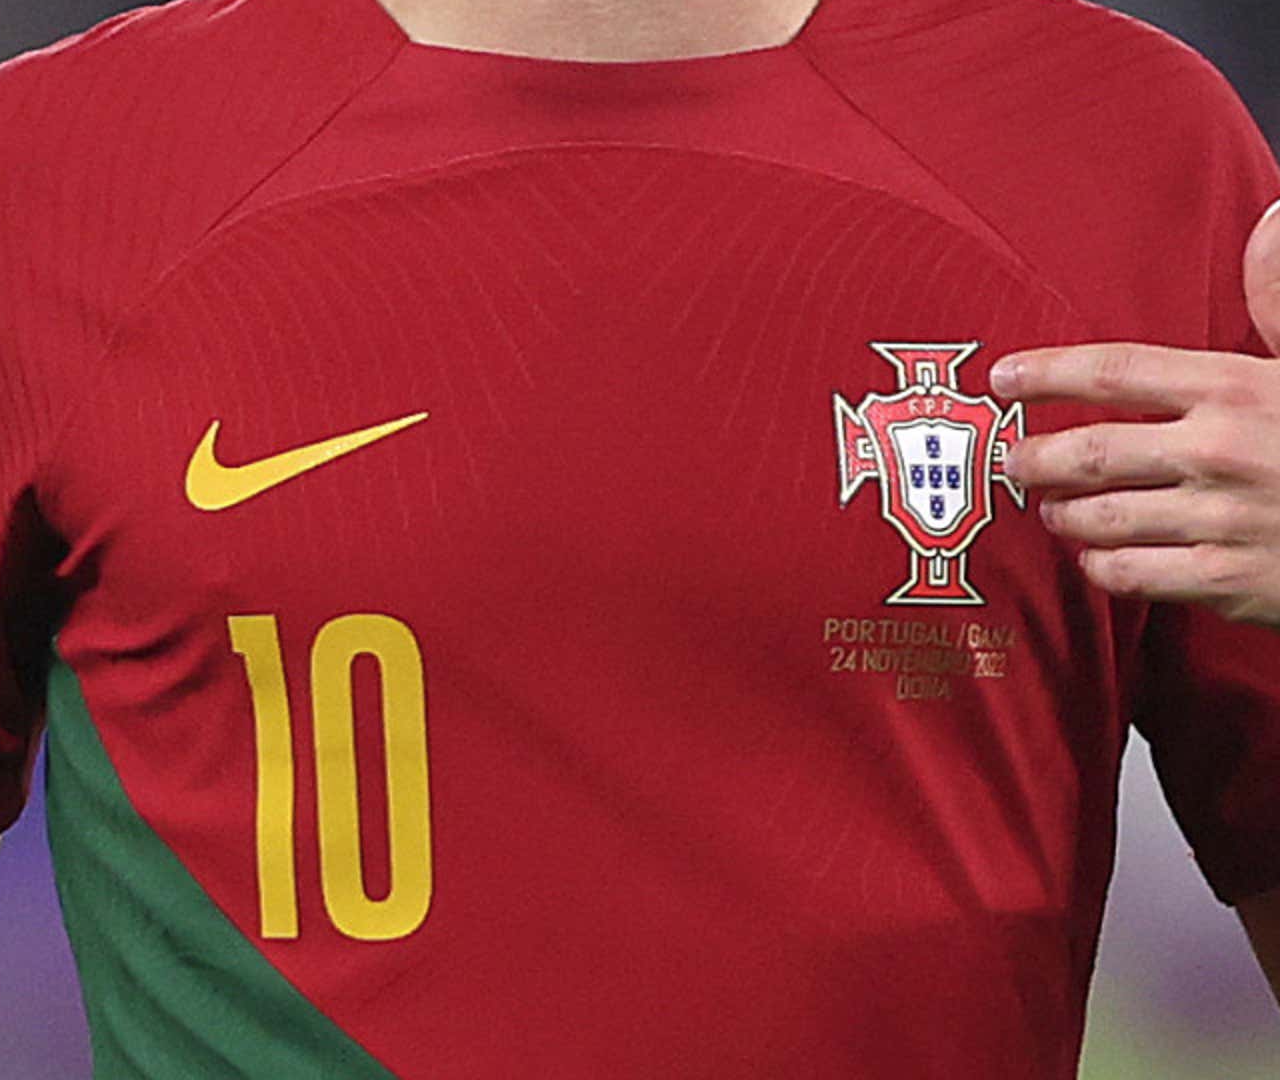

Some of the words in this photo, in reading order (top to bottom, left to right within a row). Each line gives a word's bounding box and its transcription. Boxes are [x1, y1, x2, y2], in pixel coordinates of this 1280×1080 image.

[830, 646, 857, 672] 24
[862, 648, 971, 675] NOVEO
[227, 613, 432, 941] 10
